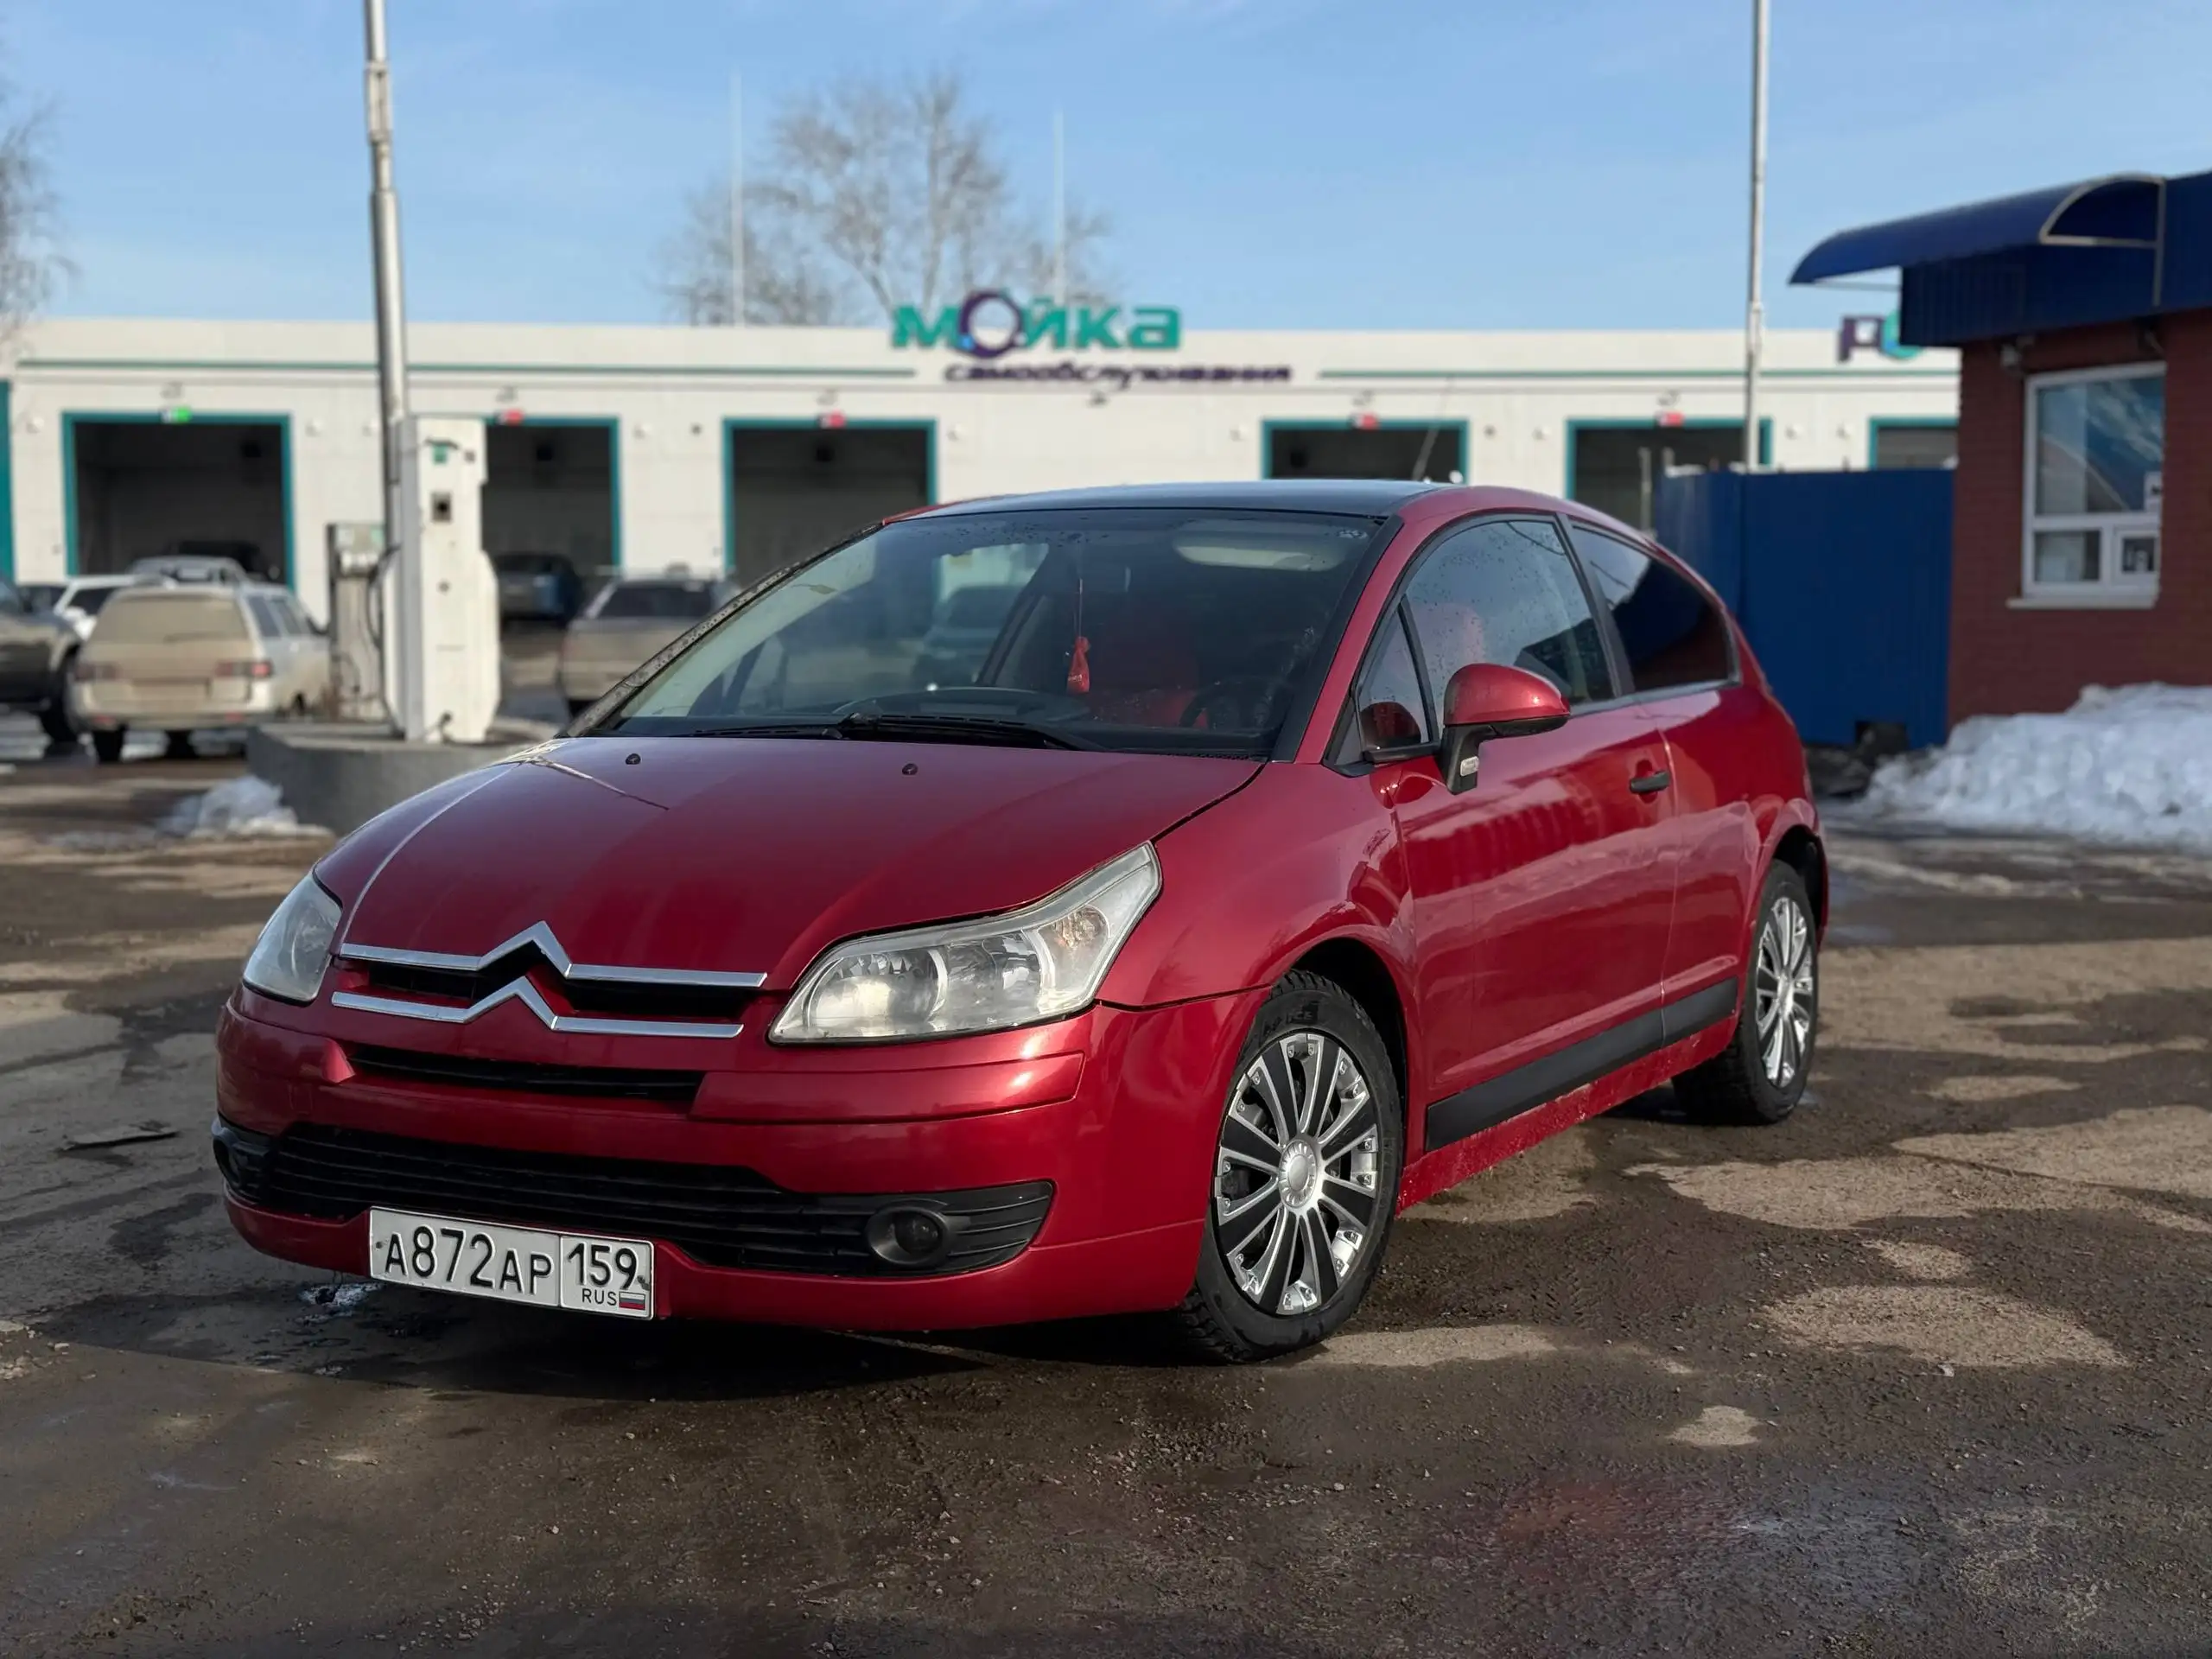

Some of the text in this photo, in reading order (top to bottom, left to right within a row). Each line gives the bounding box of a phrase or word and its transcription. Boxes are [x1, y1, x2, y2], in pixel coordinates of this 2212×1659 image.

[385, 1226, 638, 1294] А872АР 159
[582, 1288, 617, 1306] RUS
